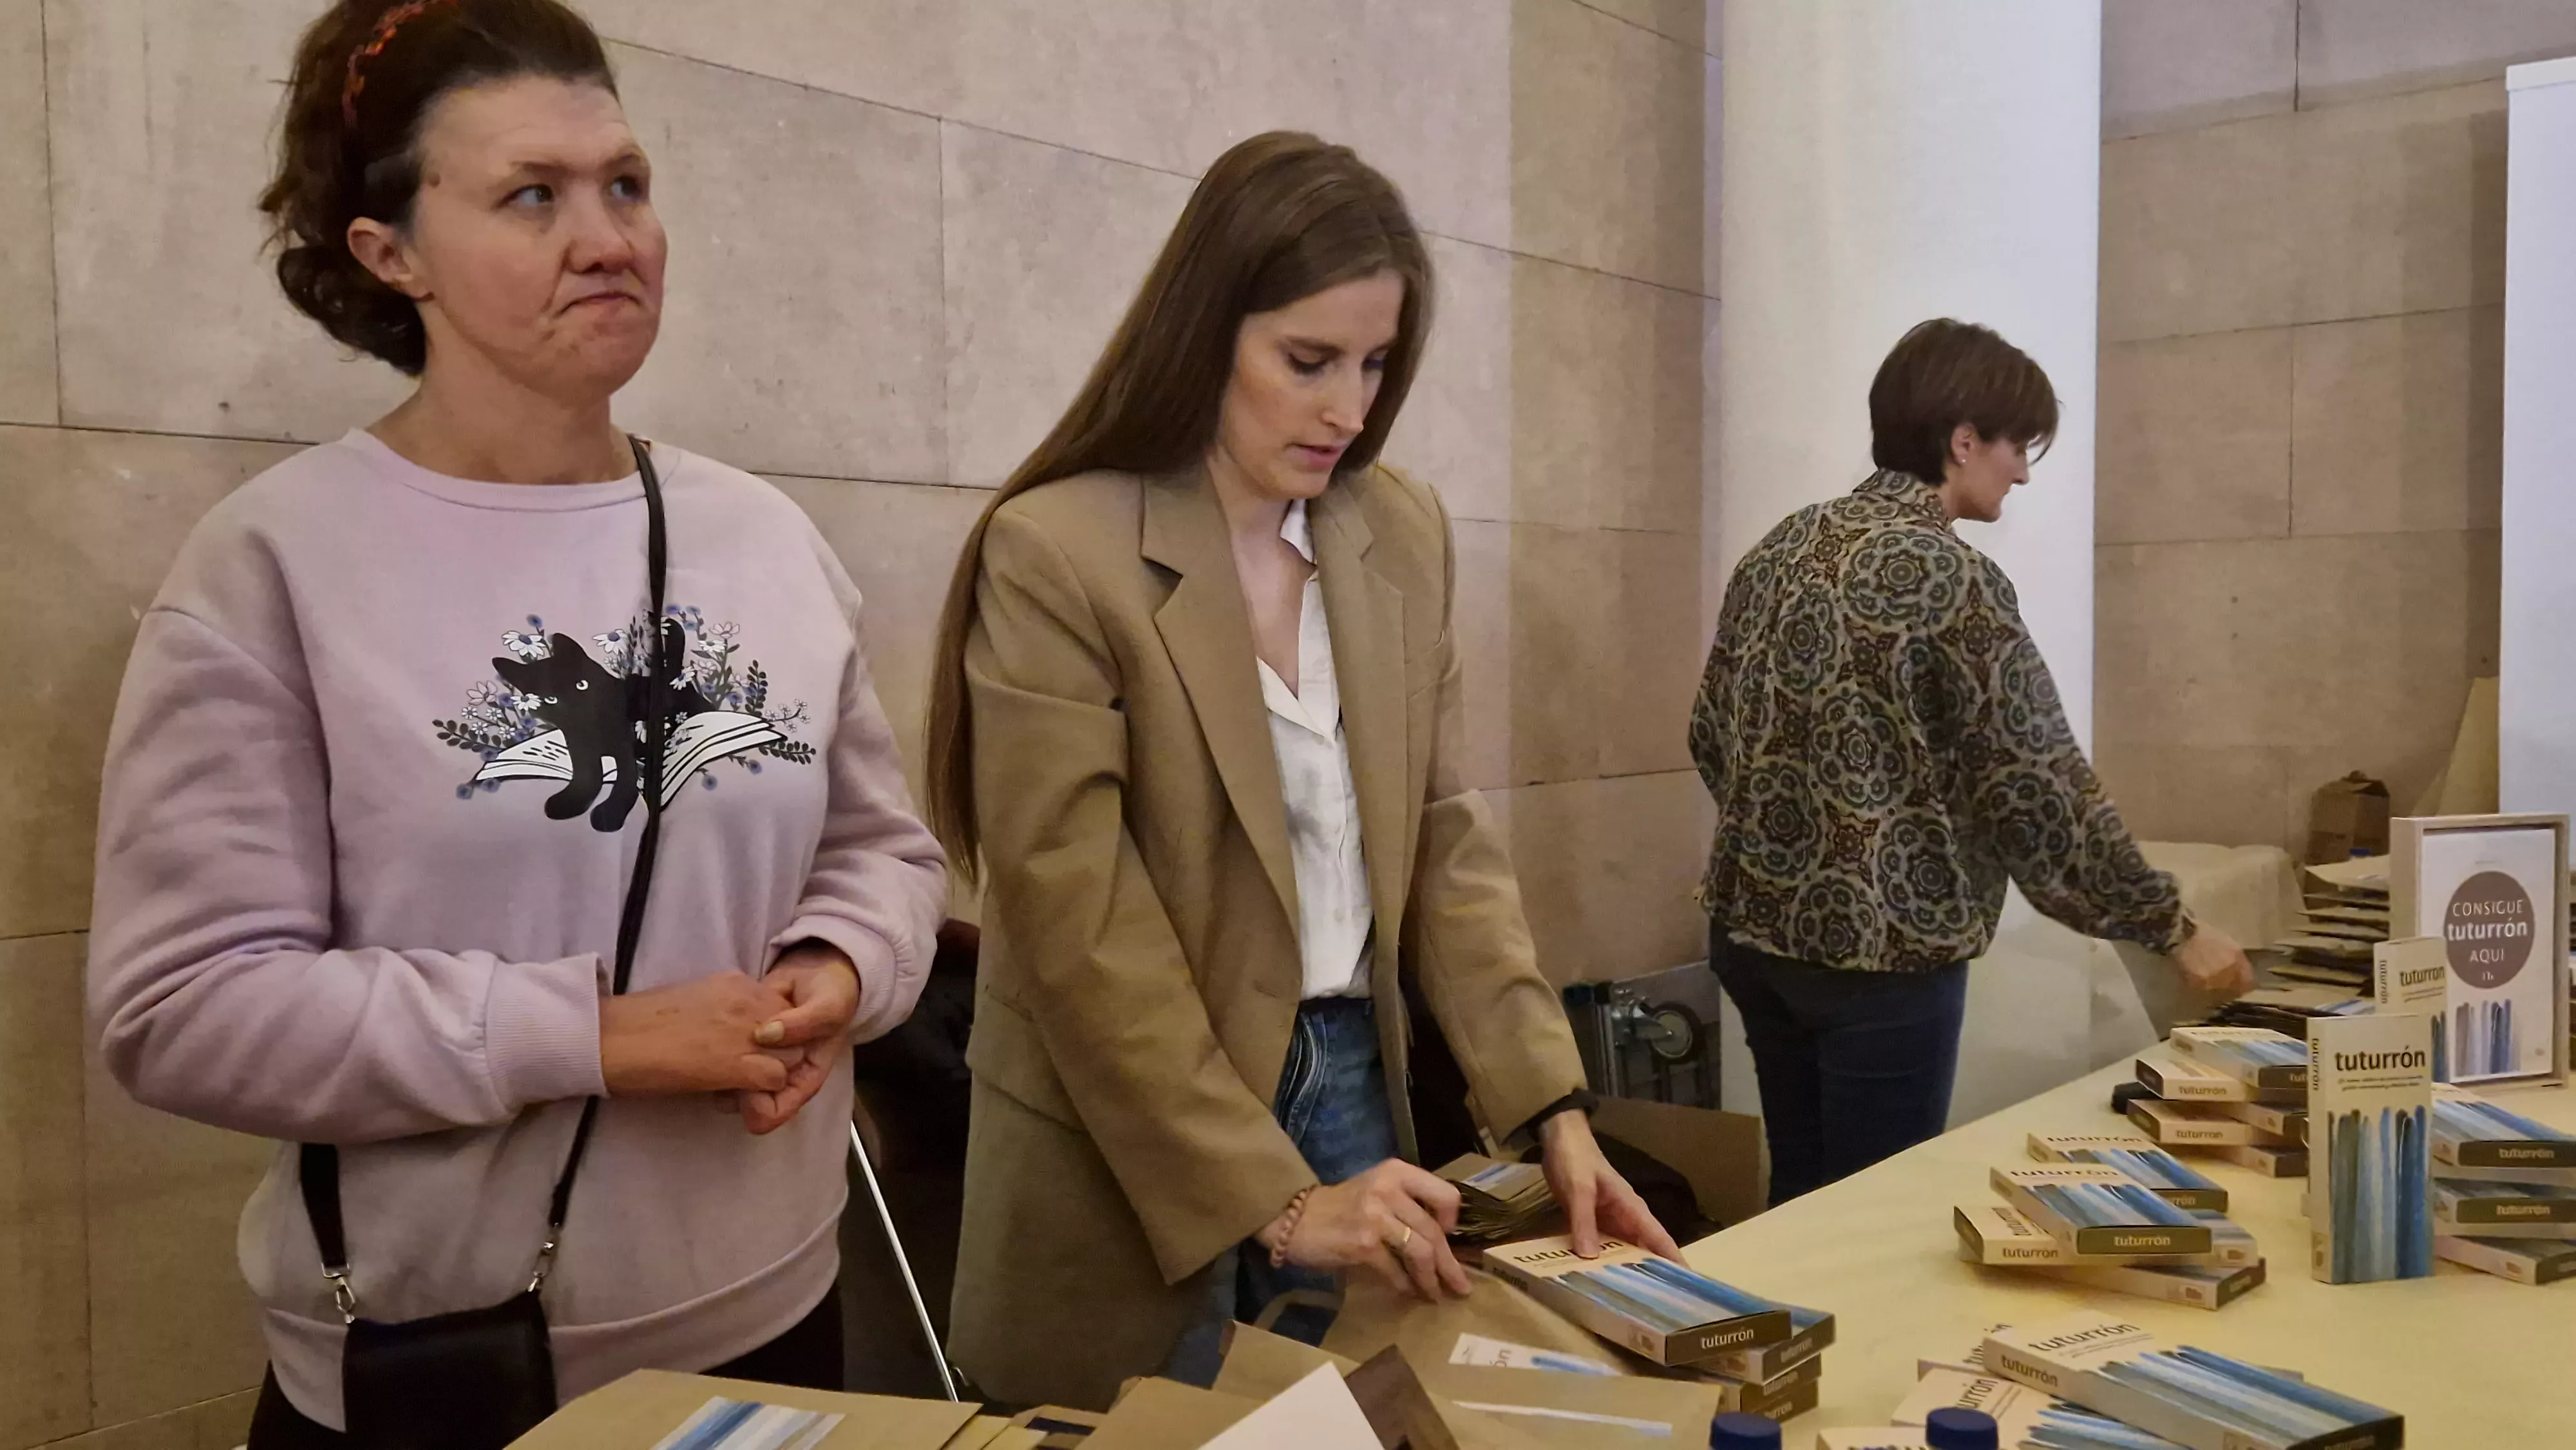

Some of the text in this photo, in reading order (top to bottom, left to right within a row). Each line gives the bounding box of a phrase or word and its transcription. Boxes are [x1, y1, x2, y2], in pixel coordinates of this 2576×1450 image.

[2452, 899, 2523, 917] CONSIGUE
[2448, 917, 2528, 941] tuturrón
[2334, 1044, 2426, 1071] tuturrón
[1701, 1327, 1755, 1350] tuturrón
[2028, 1323, 2141, 1352] tuturrón
